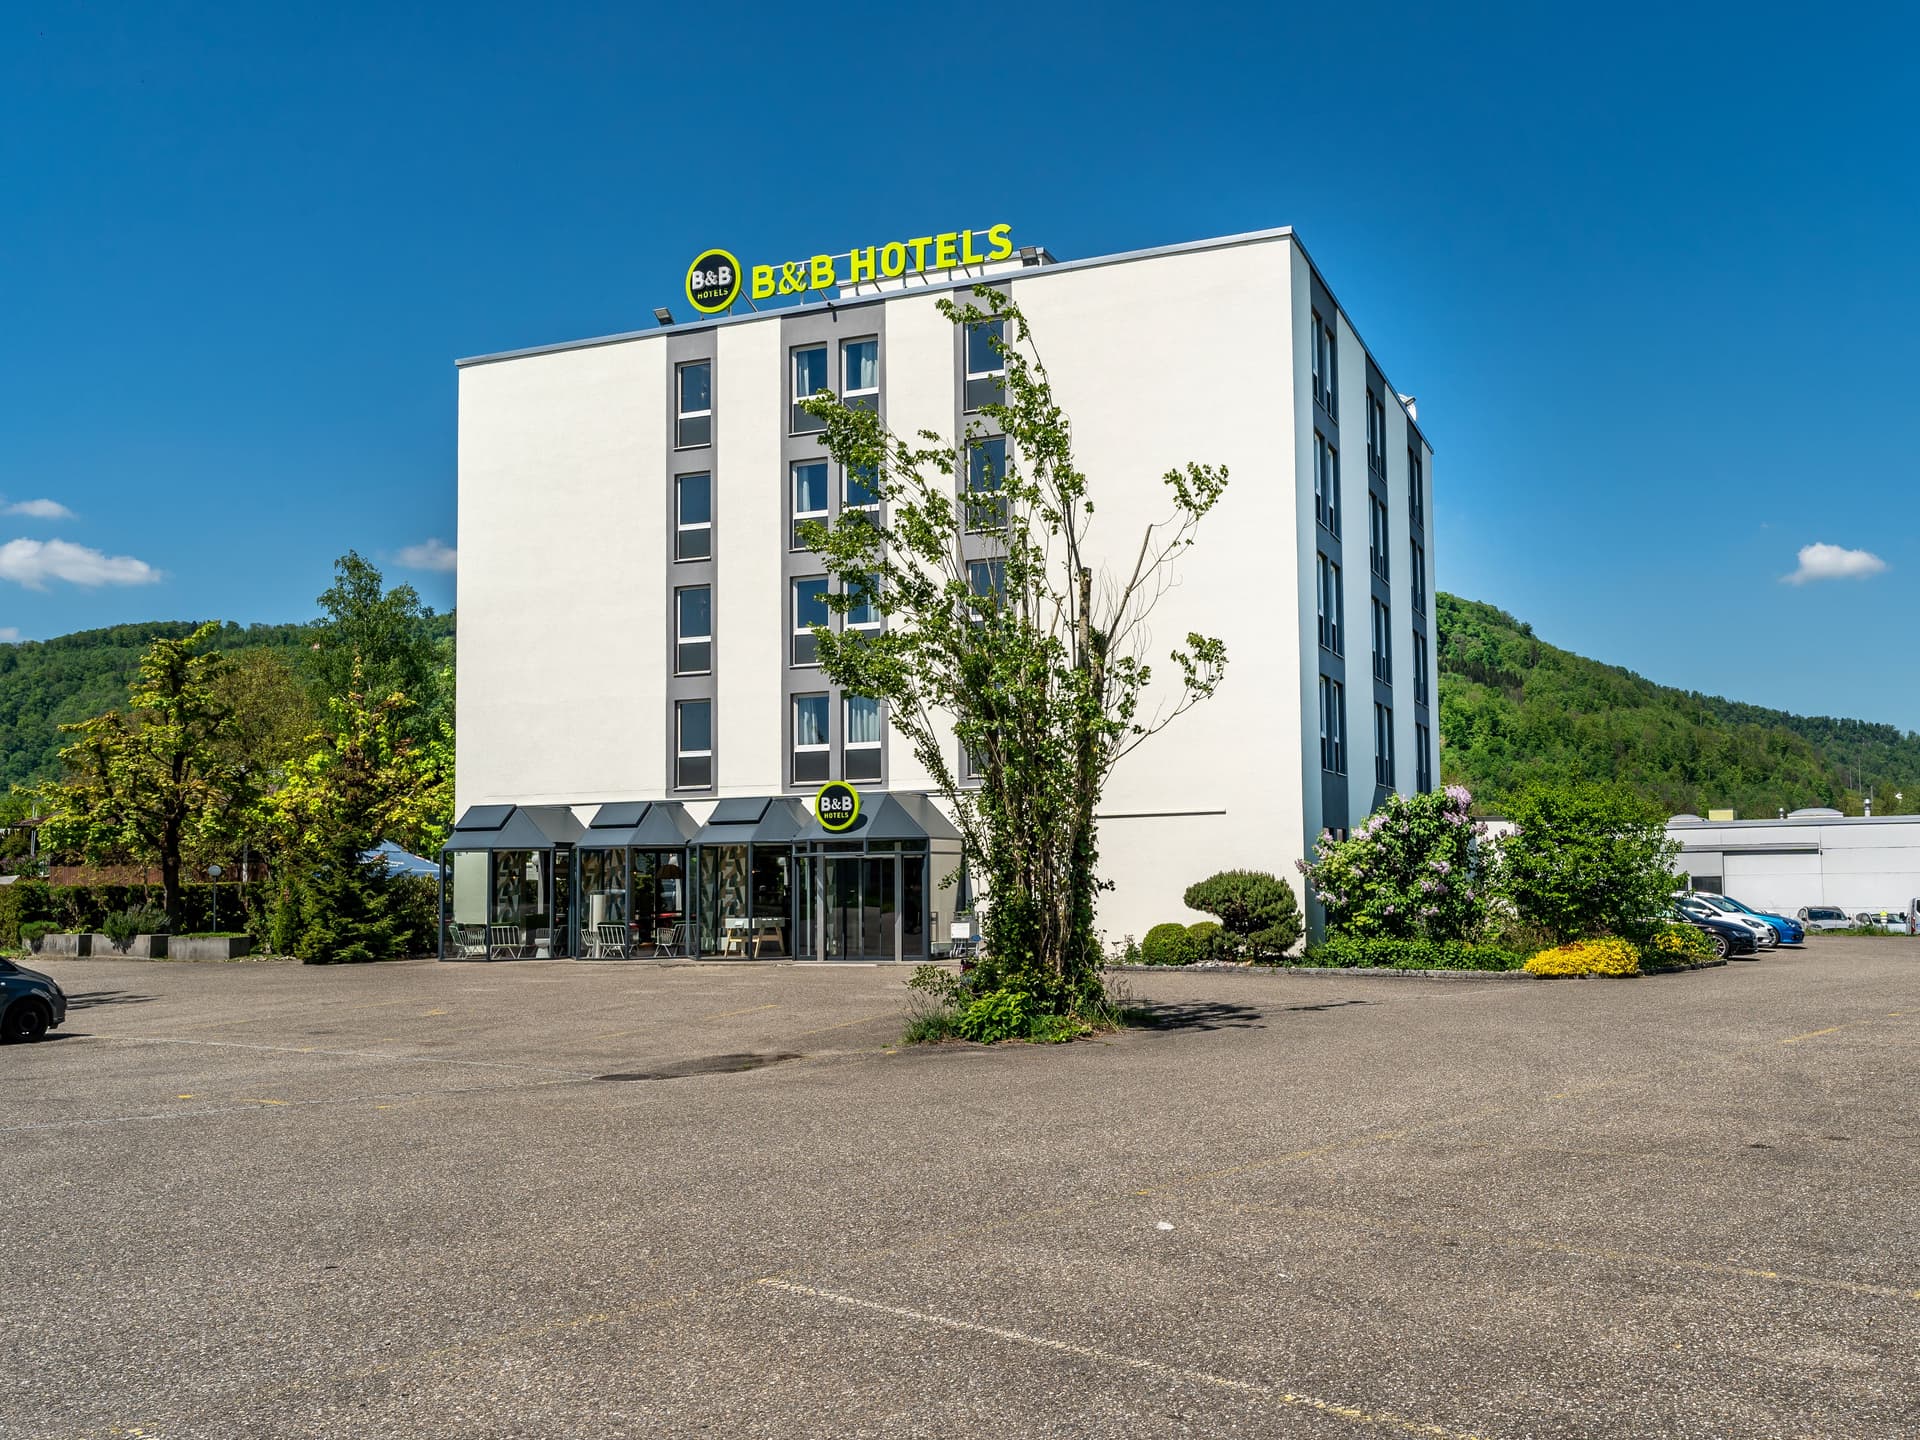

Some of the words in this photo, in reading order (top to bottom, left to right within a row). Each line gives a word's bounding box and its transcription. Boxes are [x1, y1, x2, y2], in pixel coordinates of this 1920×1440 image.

[752, 255, 836, 300] B&B
[850, 223, 1013, 283] HOTELS
[692, 266, 732, 290] B&B
[697, 288, 729, 300] HOTELS
[821, 796, 852, 811] B&B
